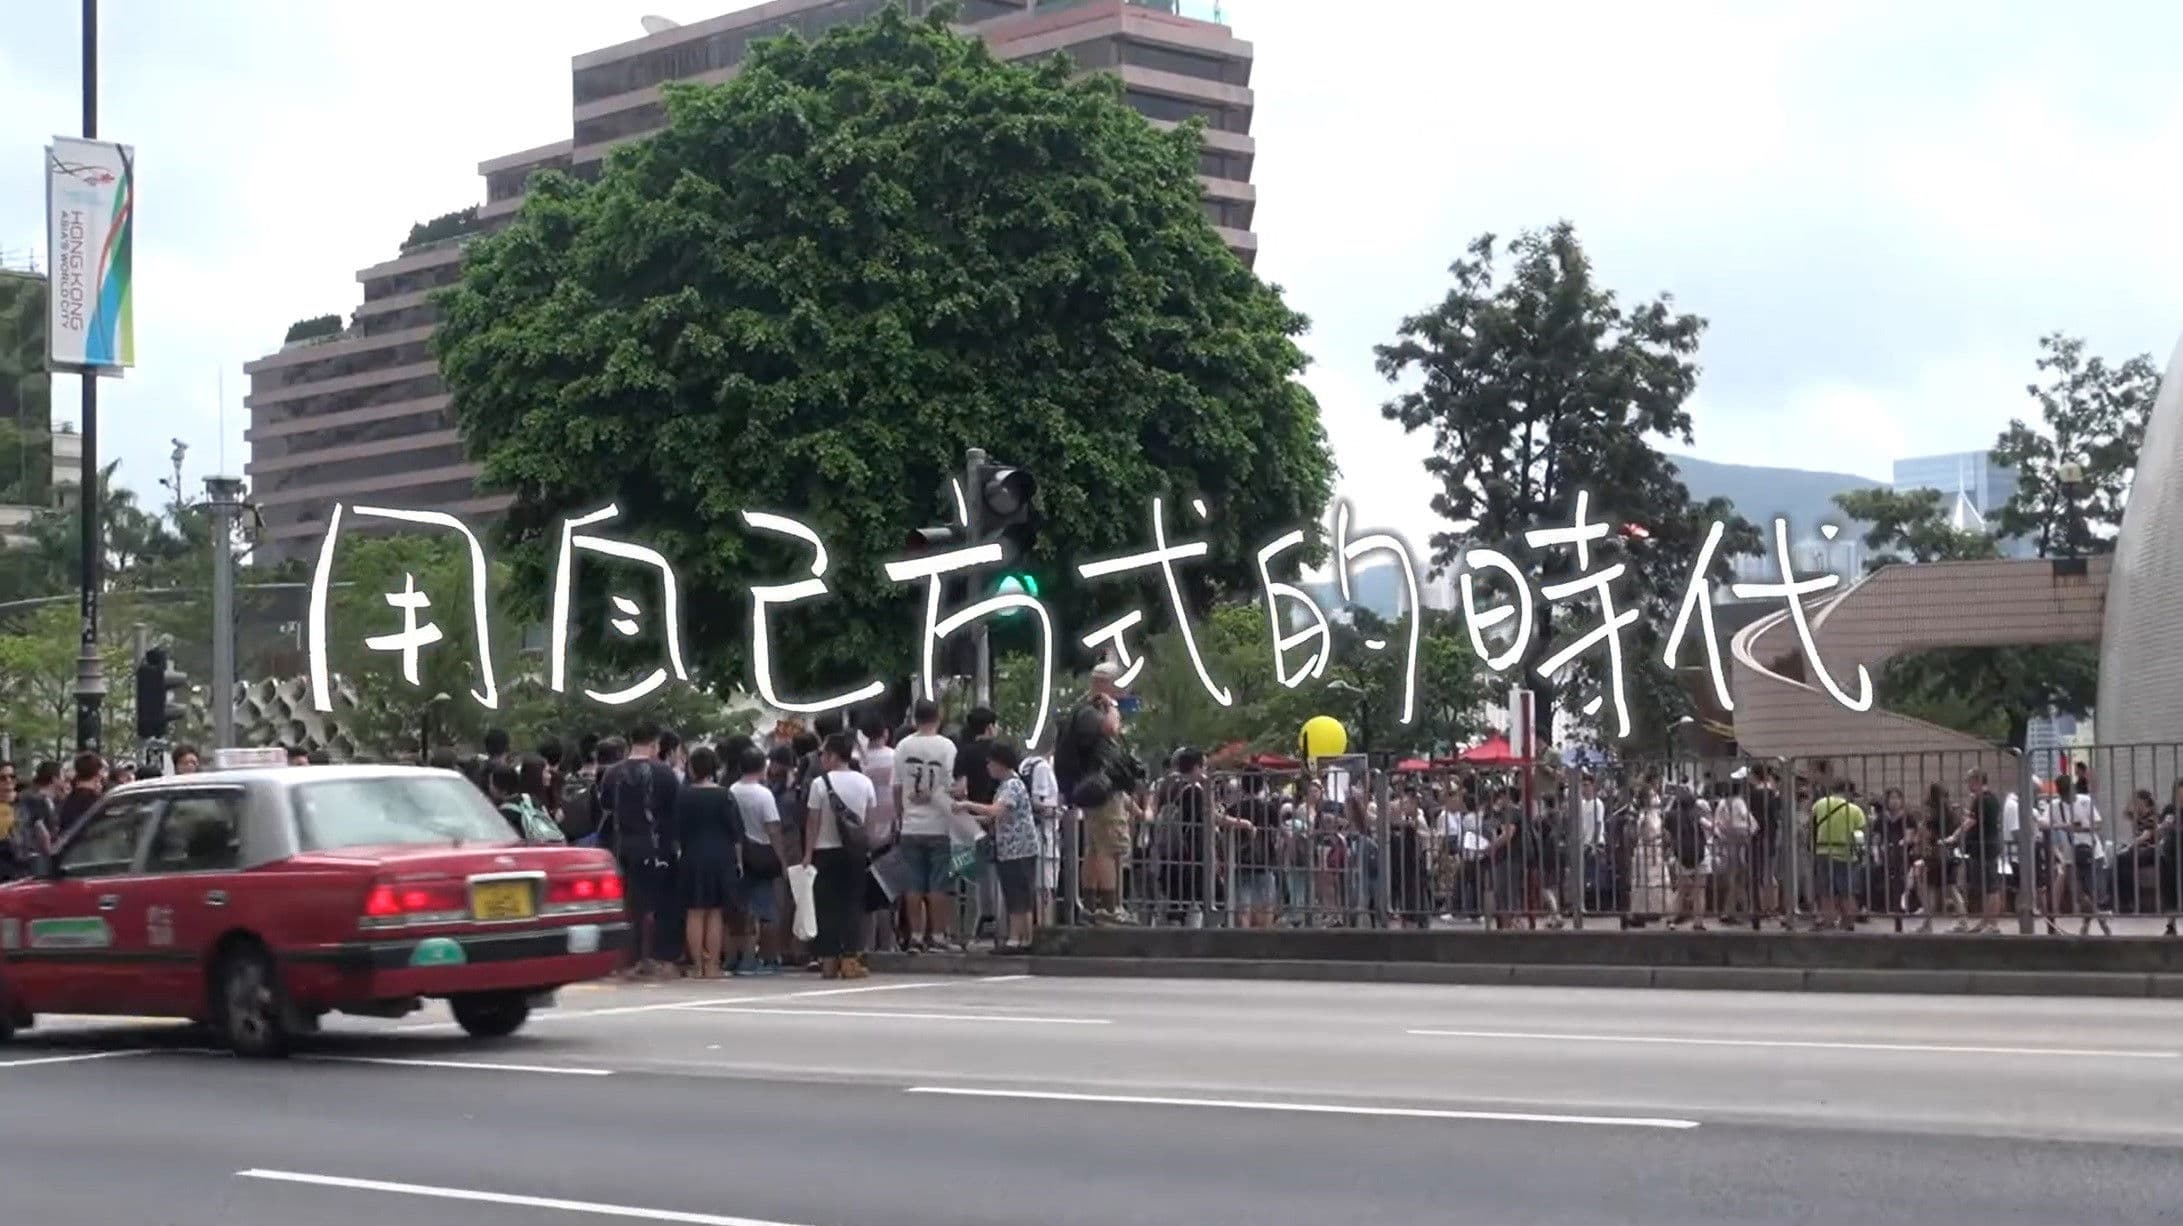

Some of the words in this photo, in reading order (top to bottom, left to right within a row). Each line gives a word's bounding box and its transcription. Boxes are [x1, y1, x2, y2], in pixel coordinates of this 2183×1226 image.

[71, 210, 83, 269] HONG
[61, 253, 69, 297] WORLD
[61, 300, 69, 328] CITY
[71, 272, 83, 331] KONG
